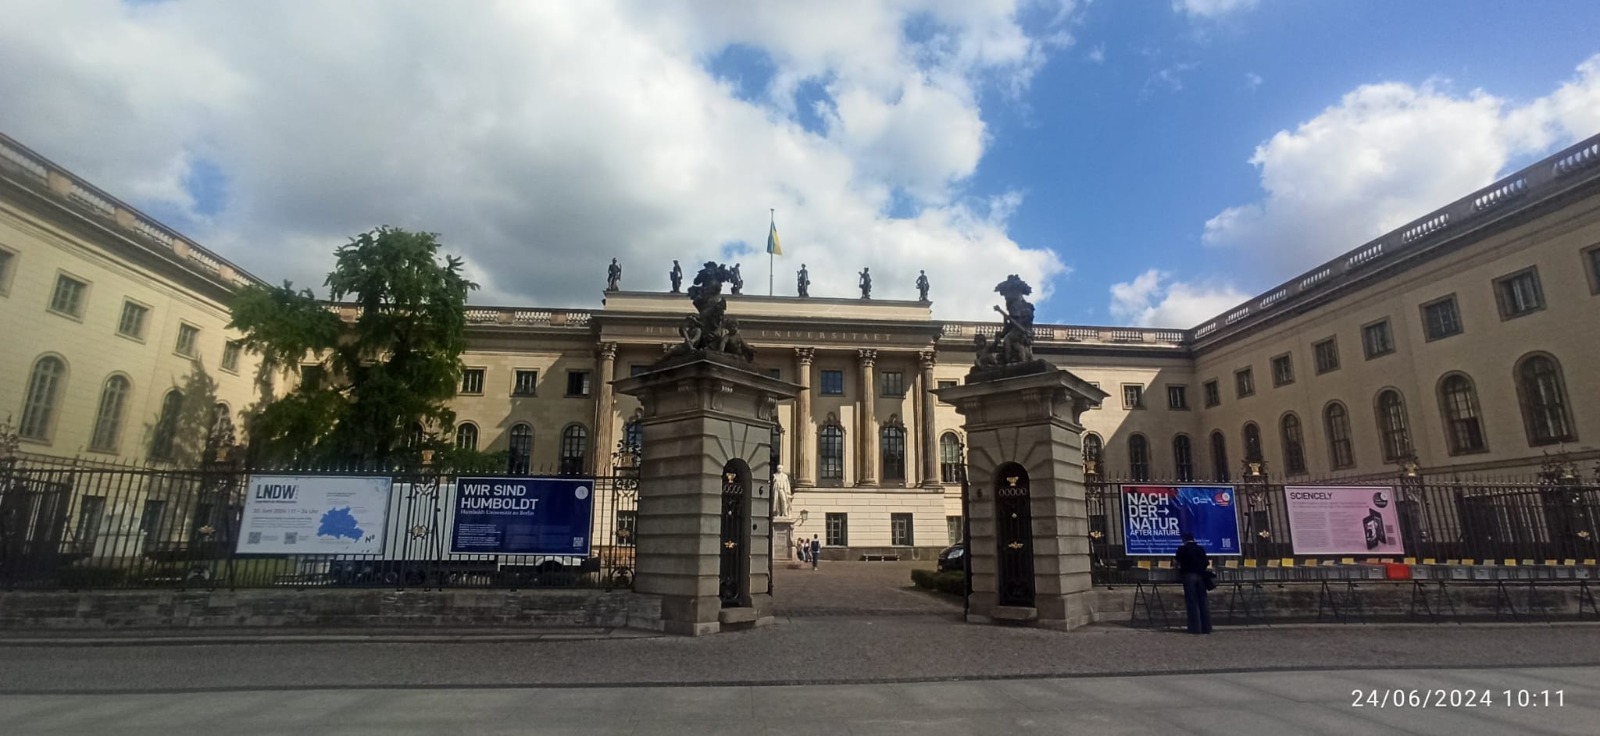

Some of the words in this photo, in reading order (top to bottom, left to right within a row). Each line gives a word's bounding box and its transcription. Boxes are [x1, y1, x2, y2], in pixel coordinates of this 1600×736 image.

[762, 330, 892, 341] UNIVERSITAET
[256, 484, 297, 499] LNDW
[463, 484, 490, 496] WIR
[493, 484, 526, 496] SIND
[1290, 492, 1332, 500] SCIENCELY
[460, 497, 539, 510] HUMBOLDT
[1127, 492, 1169, 505] NACH
[1128, 505, 1158, 518] DER
[1129, 517, 1179, 530] NATUR
